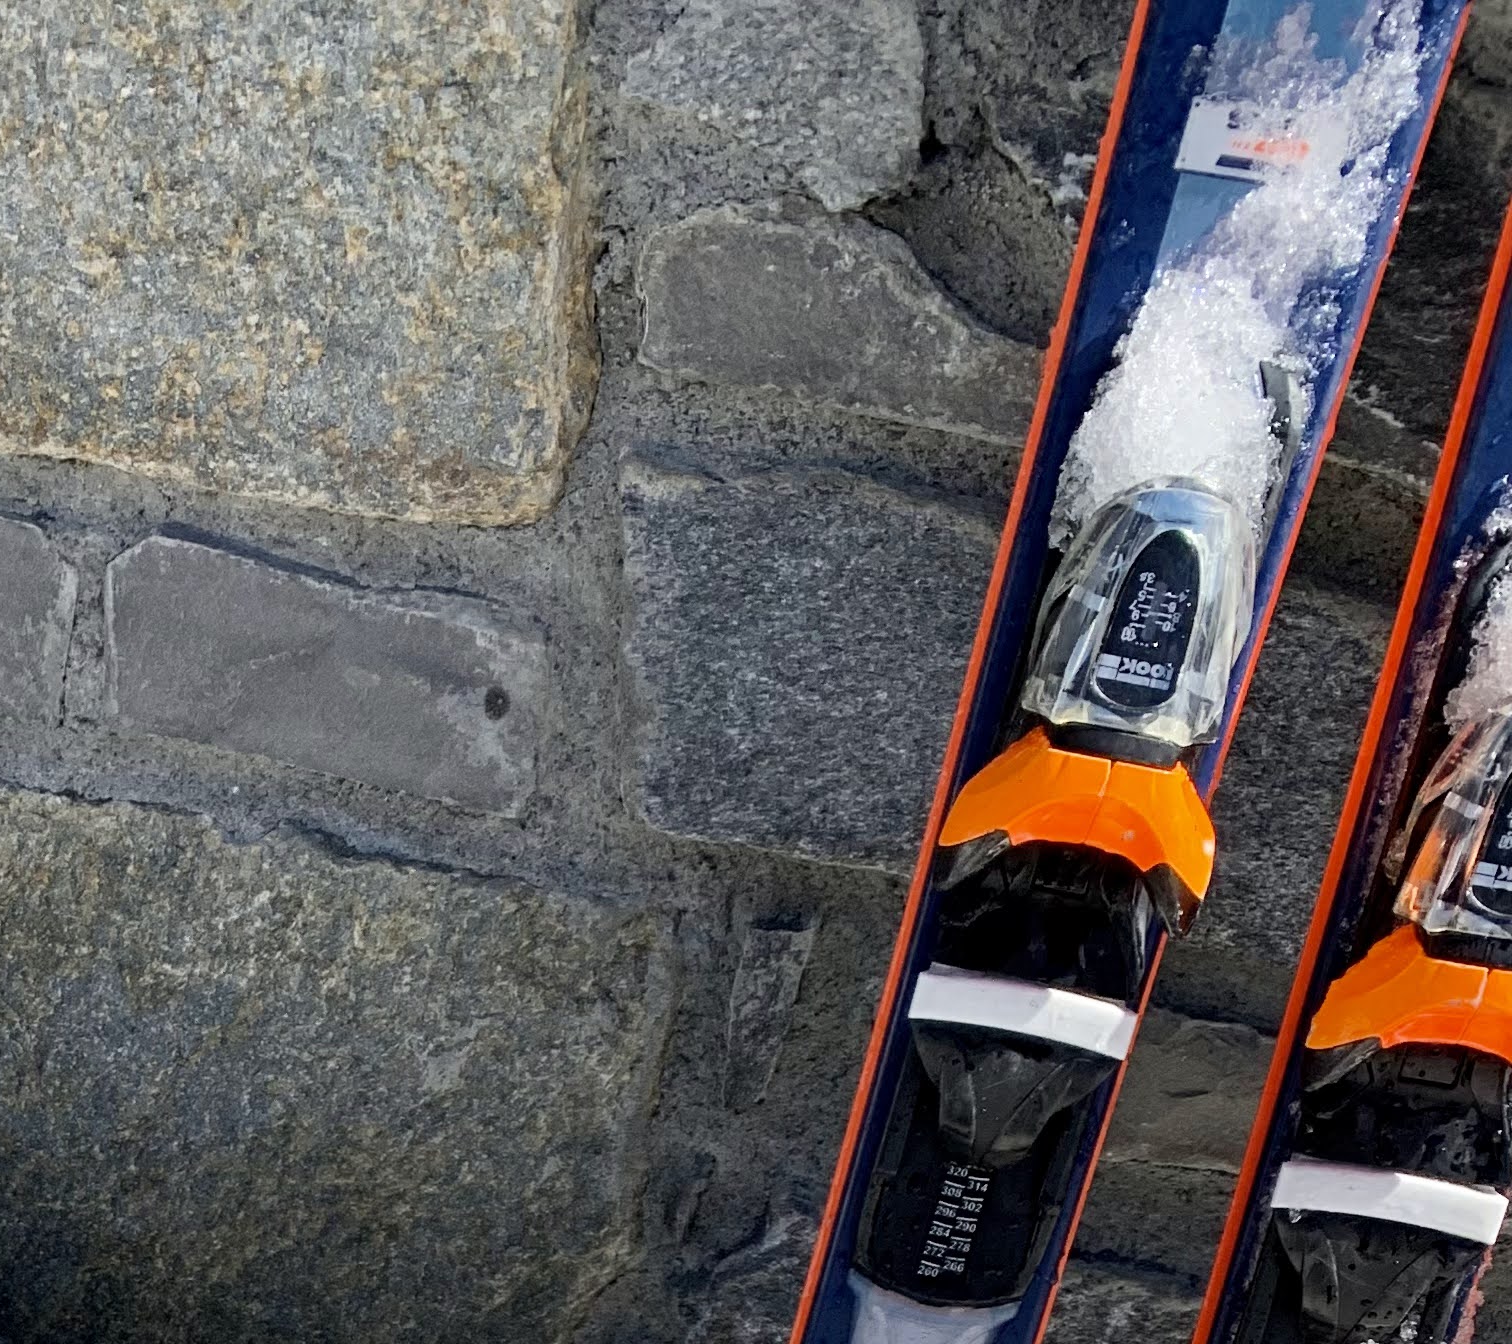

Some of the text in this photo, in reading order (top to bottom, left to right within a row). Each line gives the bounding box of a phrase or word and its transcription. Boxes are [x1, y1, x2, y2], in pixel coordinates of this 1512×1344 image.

[941, 1186, 962, 1198] 308
[967, 1181, 988, 1192] 314
[935, 1206, 956, 1218] 296
[961, 1201, 982, 1212] 302
[929, 1226, 950, 1237] 284
[955, 1221, 976, 1233] 290
[923, 1246, 945, 1257] 272
[949, 1241, 970, 1252] 278
[917, 1265, 938, 1277] 260
[943, 1260, 964, 1272] 266
